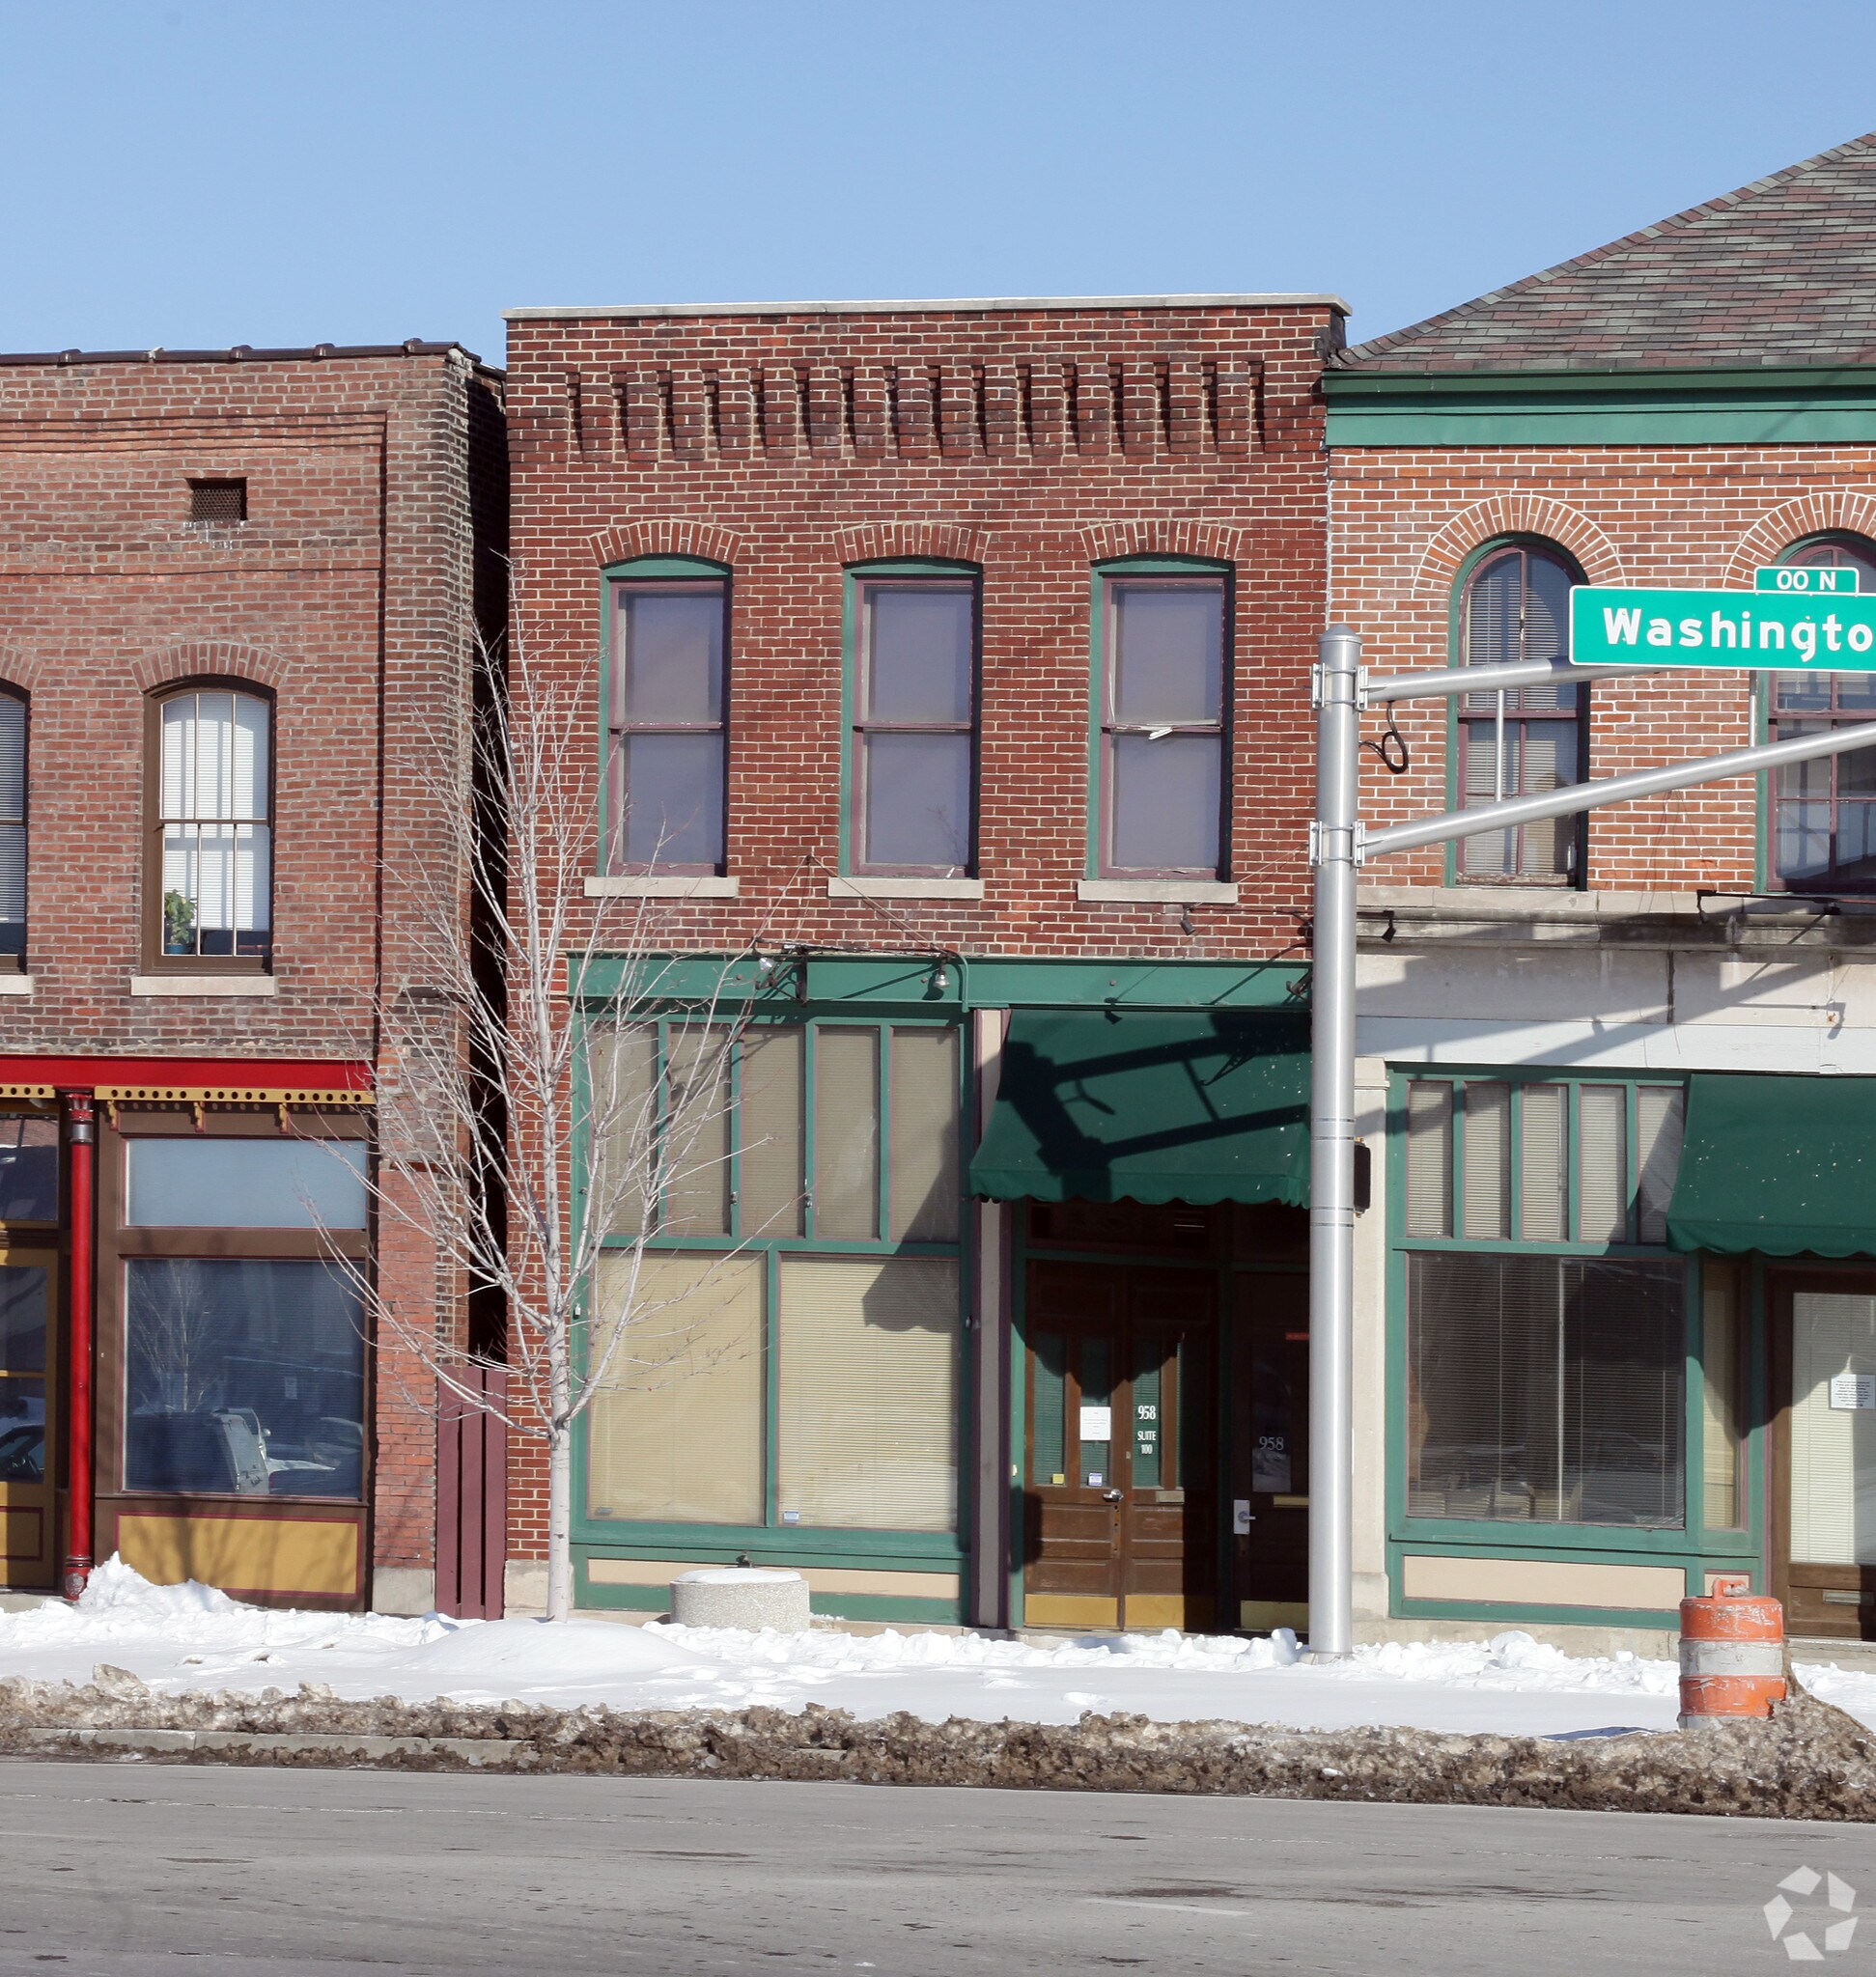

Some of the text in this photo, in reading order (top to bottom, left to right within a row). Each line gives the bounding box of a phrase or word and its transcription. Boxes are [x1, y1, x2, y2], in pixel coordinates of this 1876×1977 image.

[1819, 571, 1836, 591] N
[1603, 607, 1873, 662] Washingto
[1137, 1405, 1157, 1420] 958
[1136, 1430, 1157, 1441] SUITE
[1259, 1435, 1284, 1451] 958
